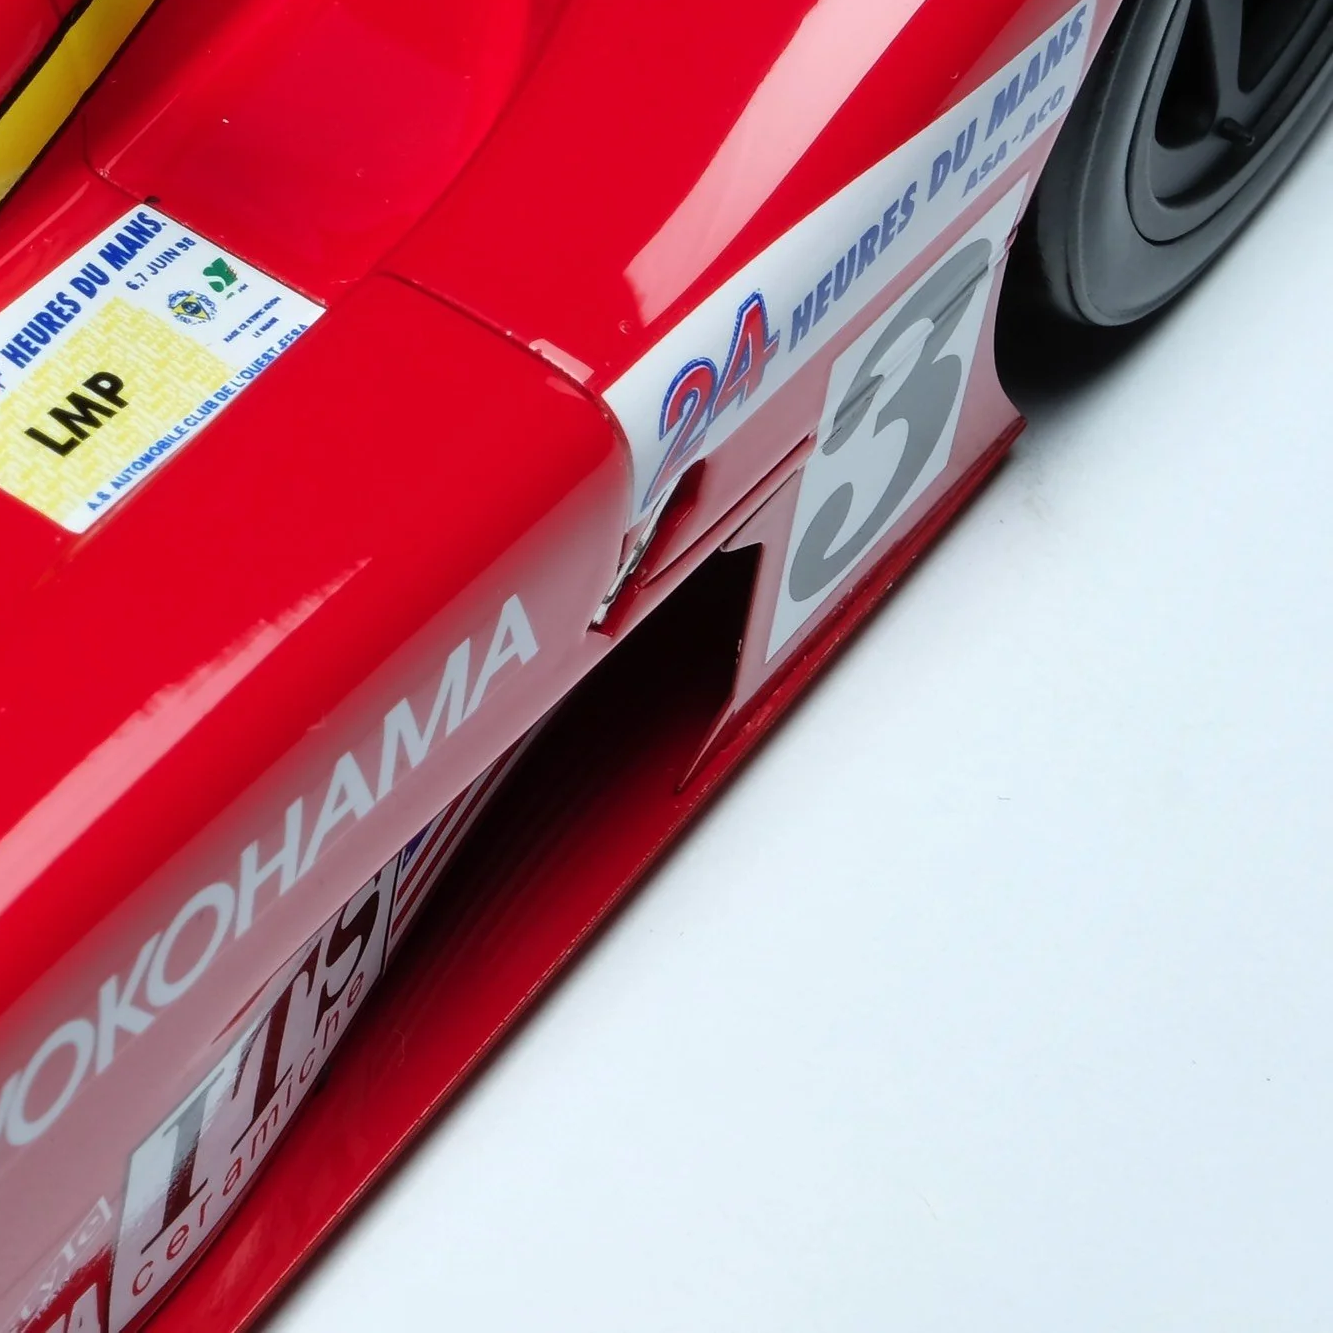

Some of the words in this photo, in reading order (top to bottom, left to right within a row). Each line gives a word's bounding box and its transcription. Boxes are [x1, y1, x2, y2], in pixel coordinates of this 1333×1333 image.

[146, 247, 182, 276] JUIN
[174, 236, 197, 252] 98
[642, 289, 781, 513] 24
[788, 180, 918, 354] HEURES
[927, 117, 978, 202] DU
[984, 3, 1088, 142] MANS
[0, 290, 82, 369] HEURES
[69, 262, 111, 300] DU
[24, 371, 129, 457] LMP
[110, 425, 190, 490] AUTOMOBILE
[183, 399, 219, 427] CLUB
[213, 384, 237, 407] DE
[788, 237, 993, 603] 3
[131, 972, 367, 1299] ceramiche
